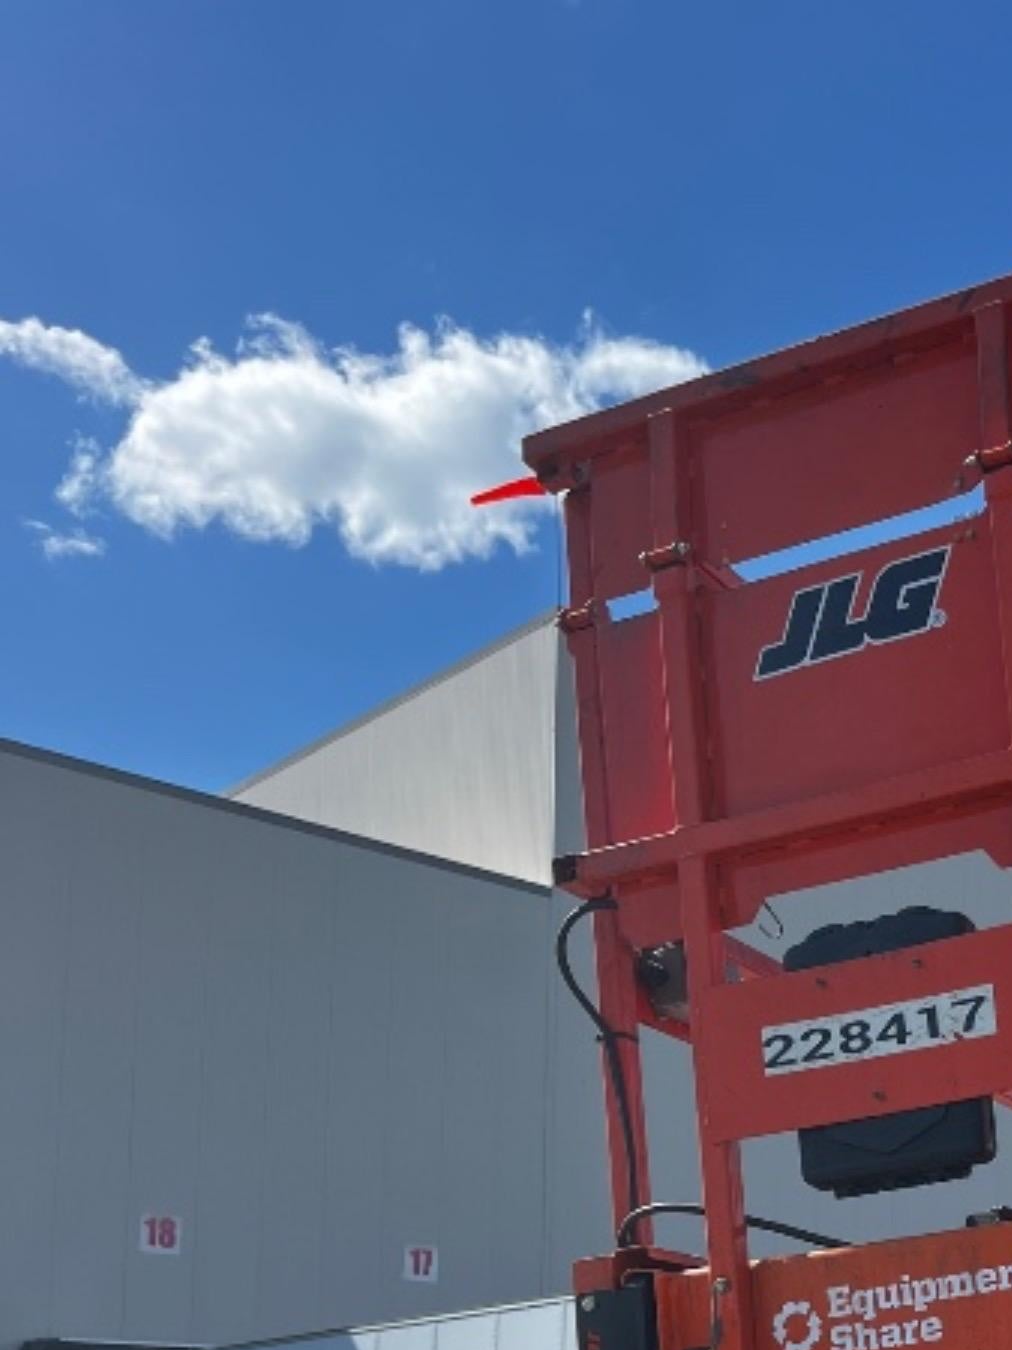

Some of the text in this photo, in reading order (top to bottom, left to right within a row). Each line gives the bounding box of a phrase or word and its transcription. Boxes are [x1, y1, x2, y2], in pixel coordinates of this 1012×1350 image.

[753, 545, 953, 682] JLG
[763, 995, 988, 1068] 228417
[144, 1217, 177, 1249] 18
[409, 1248, 432, 1275] 17
